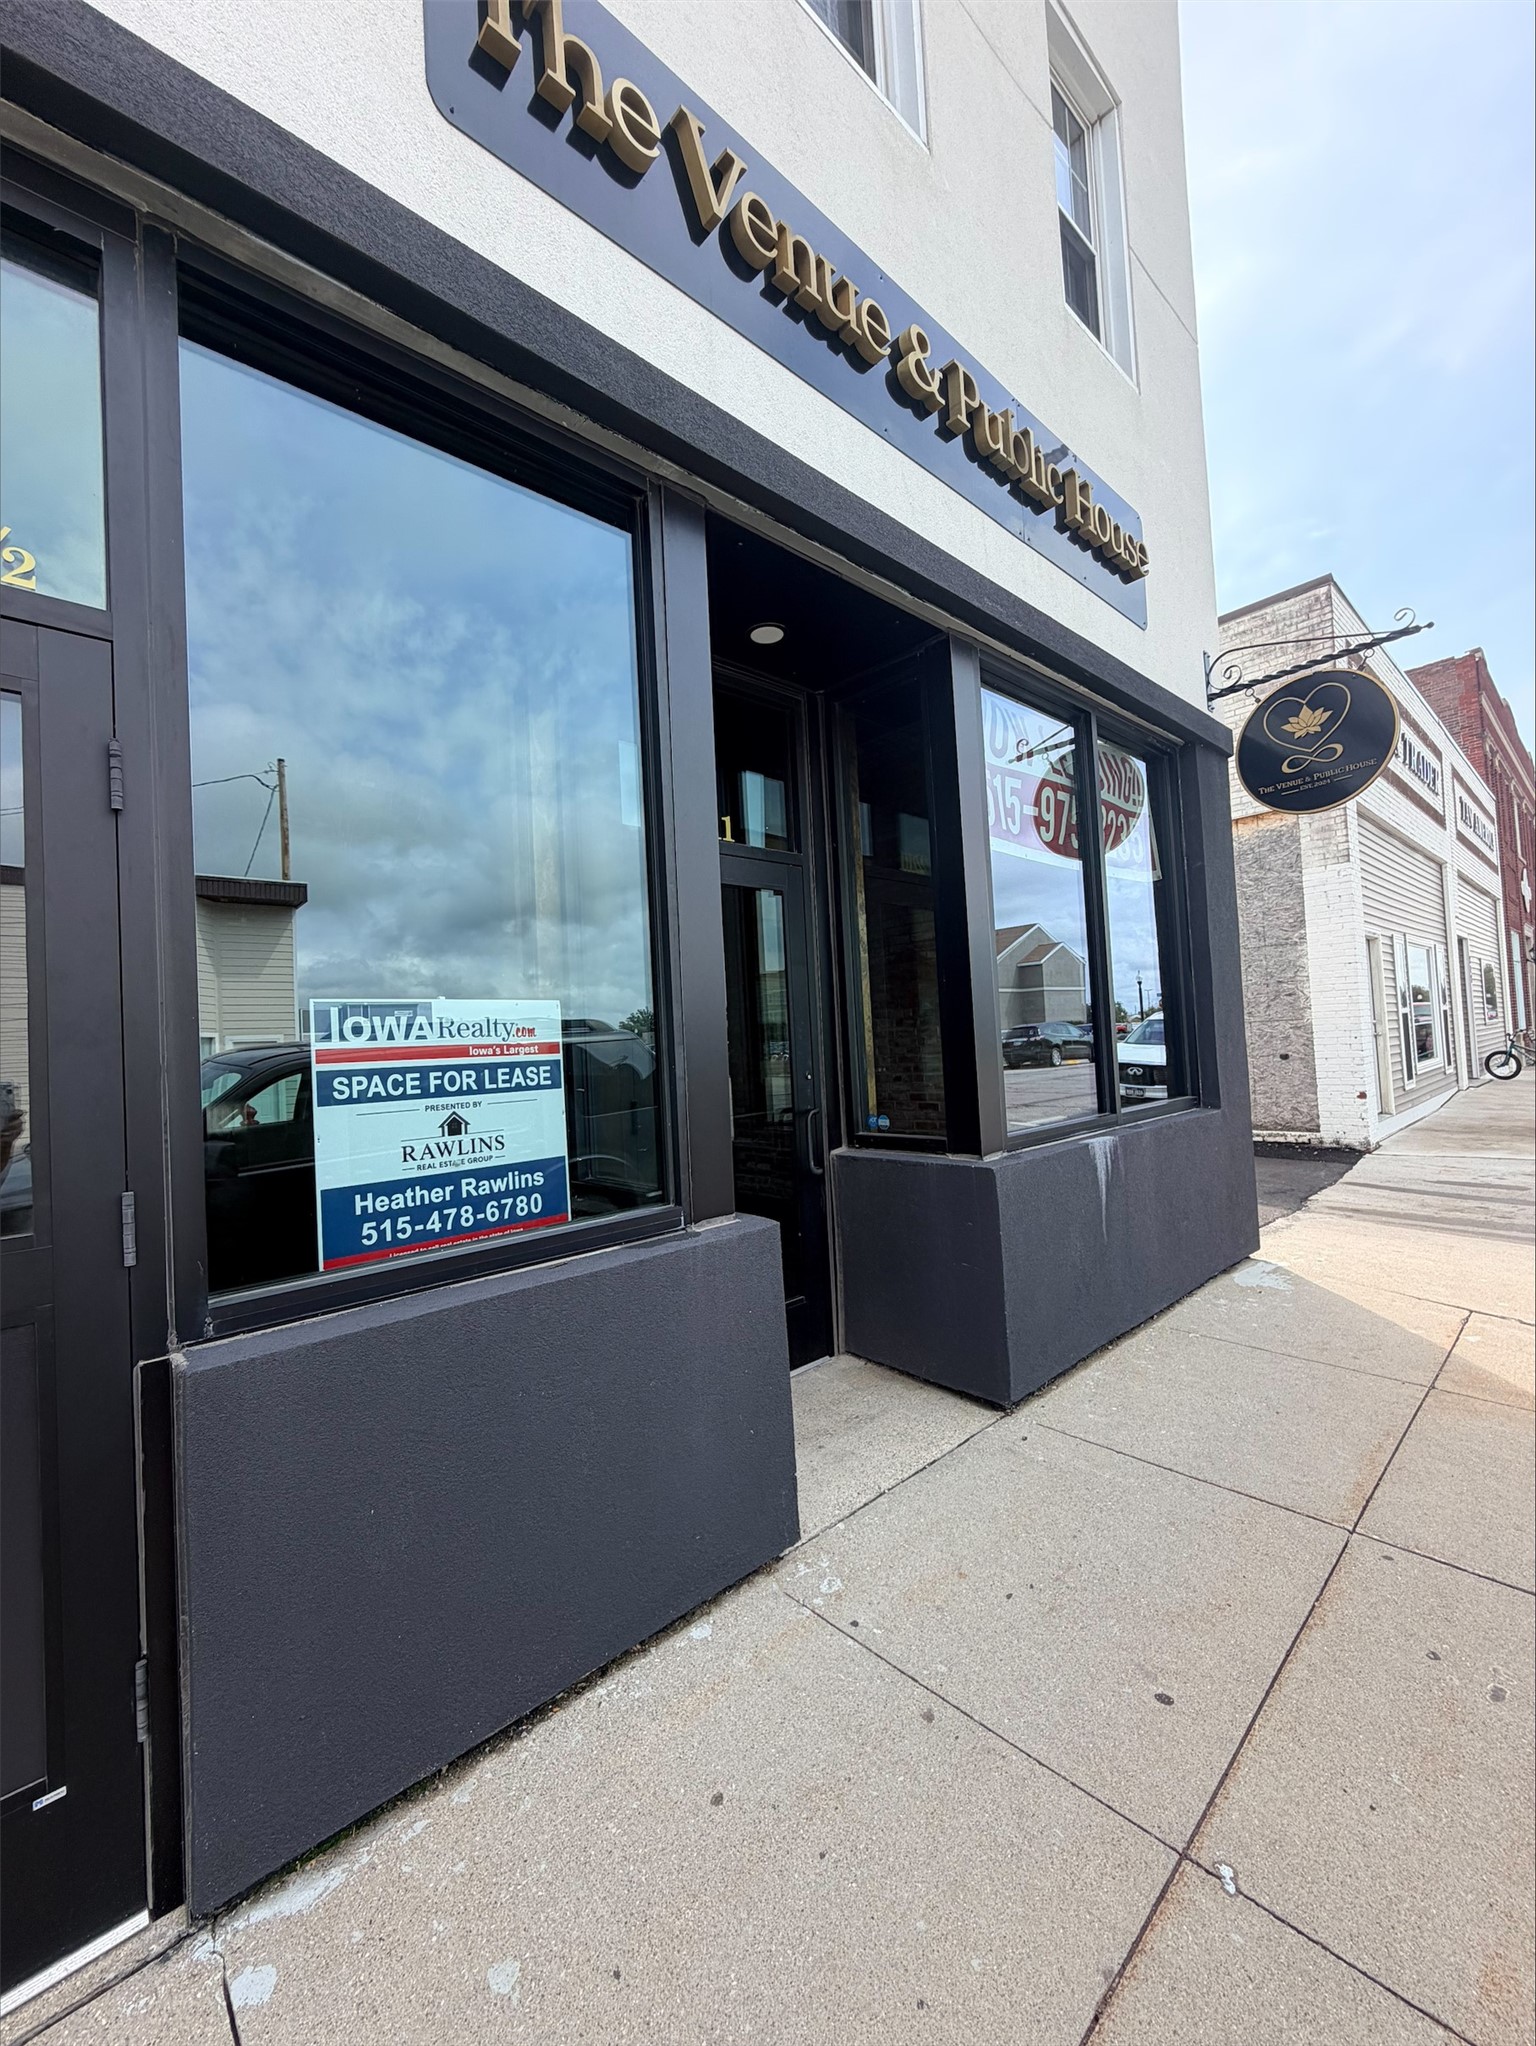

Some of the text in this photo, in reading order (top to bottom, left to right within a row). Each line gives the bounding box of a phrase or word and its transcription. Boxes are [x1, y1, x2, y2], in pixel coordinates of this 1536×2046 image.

[670, 104, 892, 365] Venue
[897, 323, 946, 411] &
[942, 358, 1064, 509] Public
[1062, 467, 1150, 579] House
[0, 526, 37, 590] 2
[1258, 786, 1275, 795] THE
[1276, 777, 1304, 790] VENUE
[1313, 766, 1345, 781] PUBLIC
[1345, 758, 1378, 772] HOUSE
[718, 815, 736, 843] 1
[330, 1006, 434, 1043] IOWA
[469, 1044, 539, 1056] Iowa's Largest
[332, 1066, 552, 1100] SPACE FOR LEASE
[425, 1100, 483, 1112] PRESENTED BY
[401, 1134, 506, 1163] RAWLINS
[416, 1163, 437, 1172] REAL
[467, 1154, 494, 1165] GROUP
[355, 1170, 545, 1216] Heather Rawlins
[361, 1193, 543, 1246] 515-478-6780
